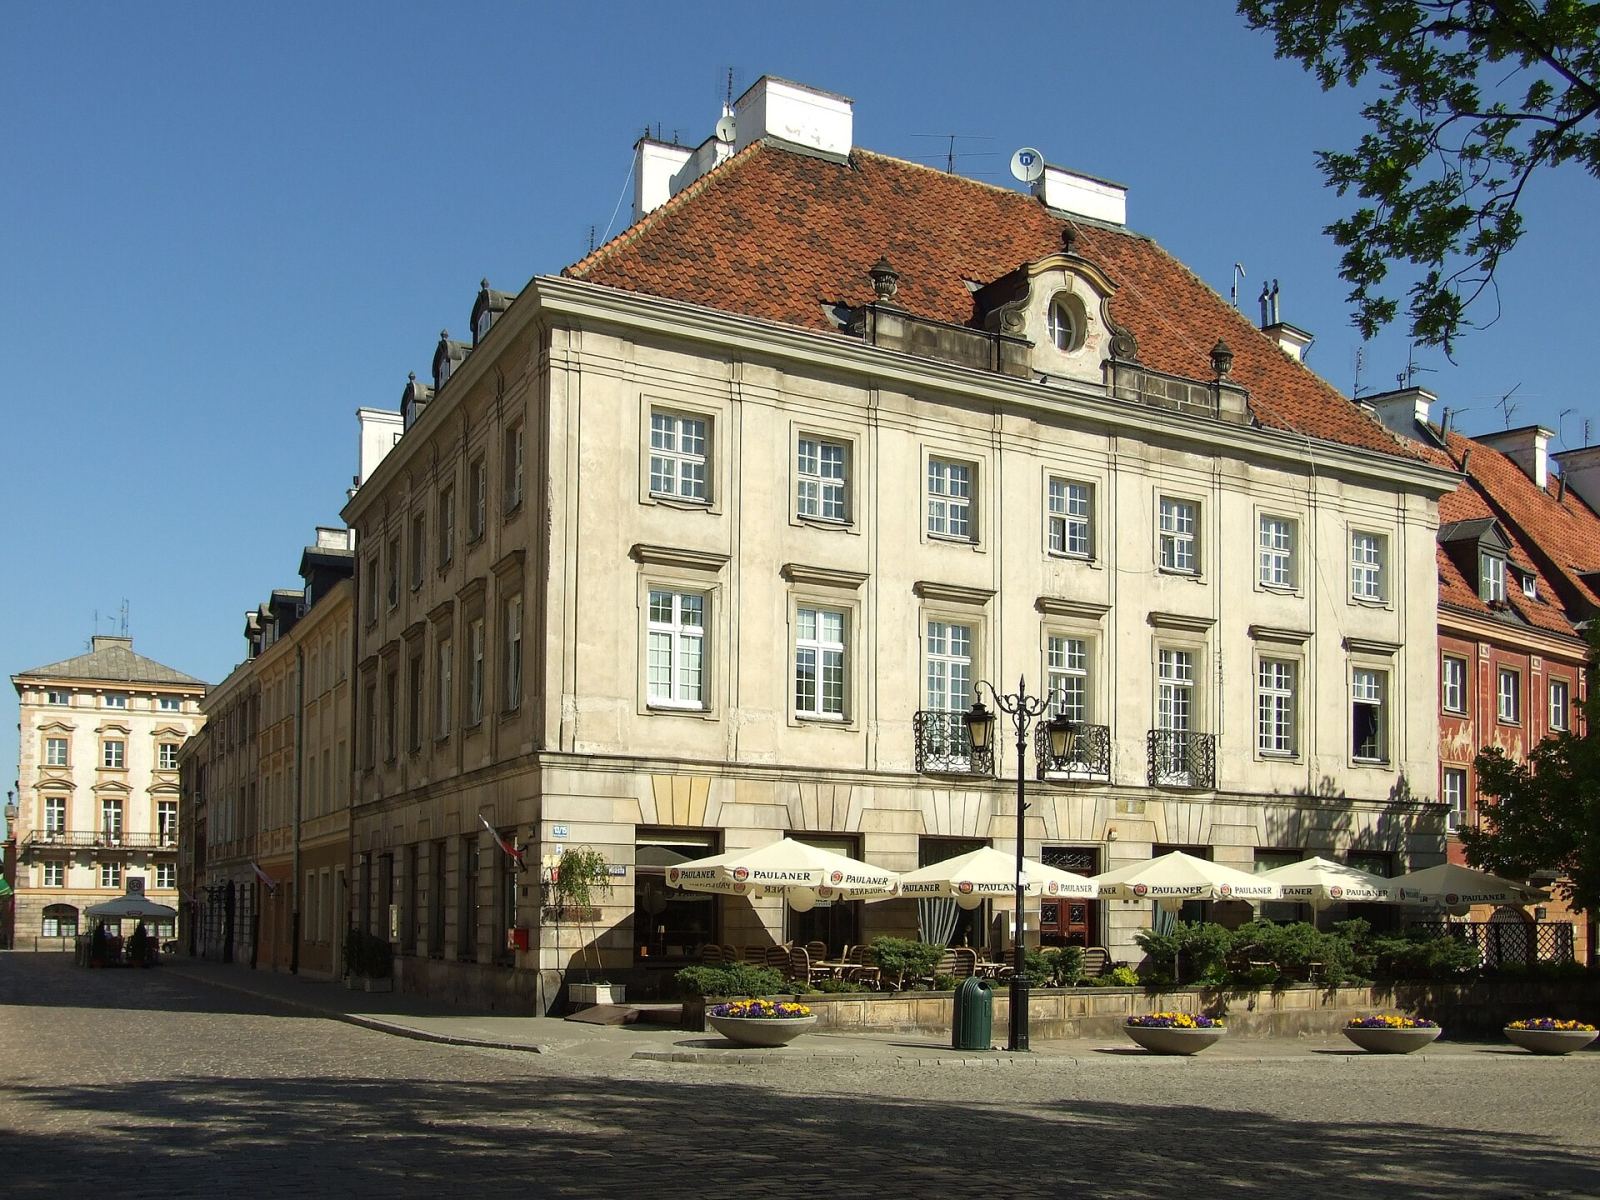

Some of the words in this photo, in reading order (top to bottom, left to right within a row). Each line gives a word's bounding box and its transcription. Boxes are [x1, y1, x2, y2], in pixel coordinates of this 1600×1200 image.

[680, 870, 716, 880] PAULANER
[753, 870, 811, 881] PAULANER
[845, 874, 889, 886] PAULANER
[902, 883, 941, 892] PAULANER
[978, 883, 1031, 892] PAULANR
[1060, 884, 1093, 893] PAULANER
[1151, 886, 1203, 894] PAULANER
[1234, 886, 1273, 895] PAULANER
[1346, 888, 1389, 897] PAULANER
[1461, 893, 1506, 902] PAULANER
